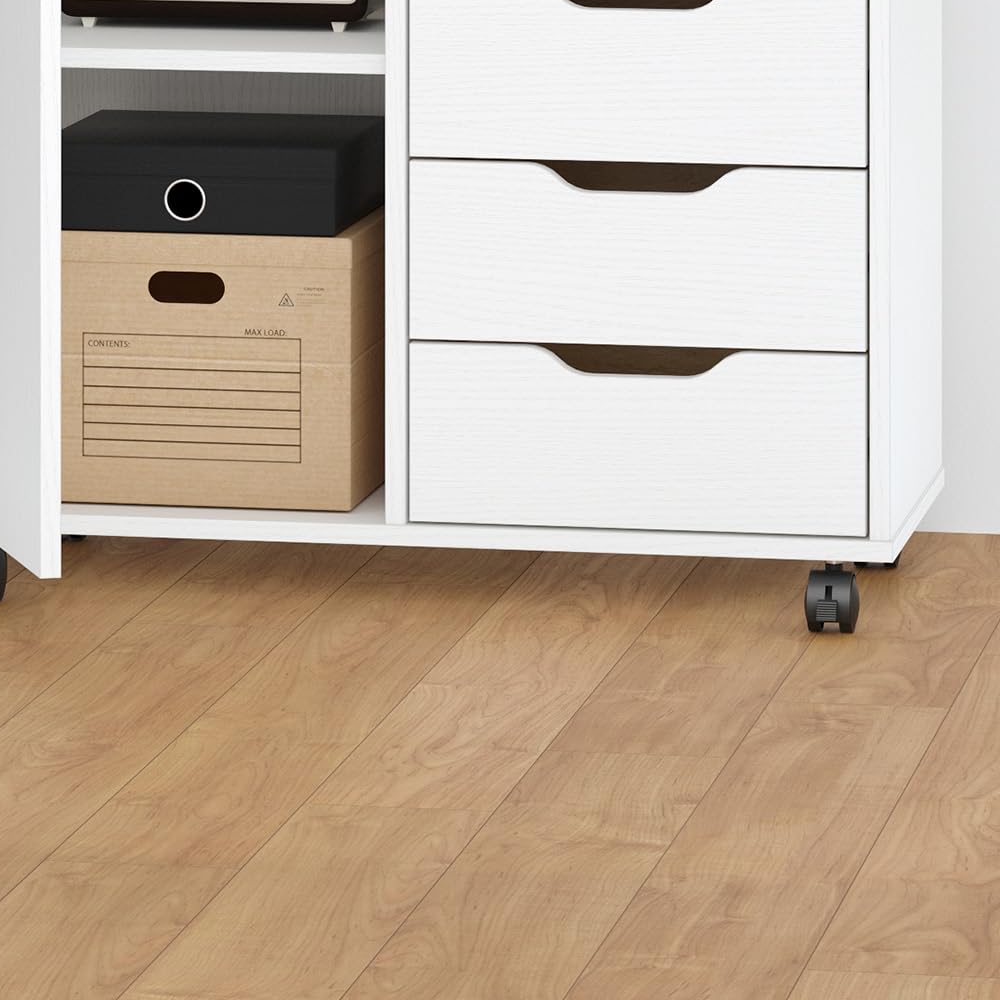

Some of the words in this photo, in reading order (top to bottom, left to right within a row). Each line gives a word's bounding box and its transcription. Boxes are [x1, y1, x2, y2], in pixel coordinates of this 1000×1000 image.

[244, 328, 262, 336] MAX
[264, 329, 287, 337] LOAD:
[87, 339, 130, 348] CONTENTS:
